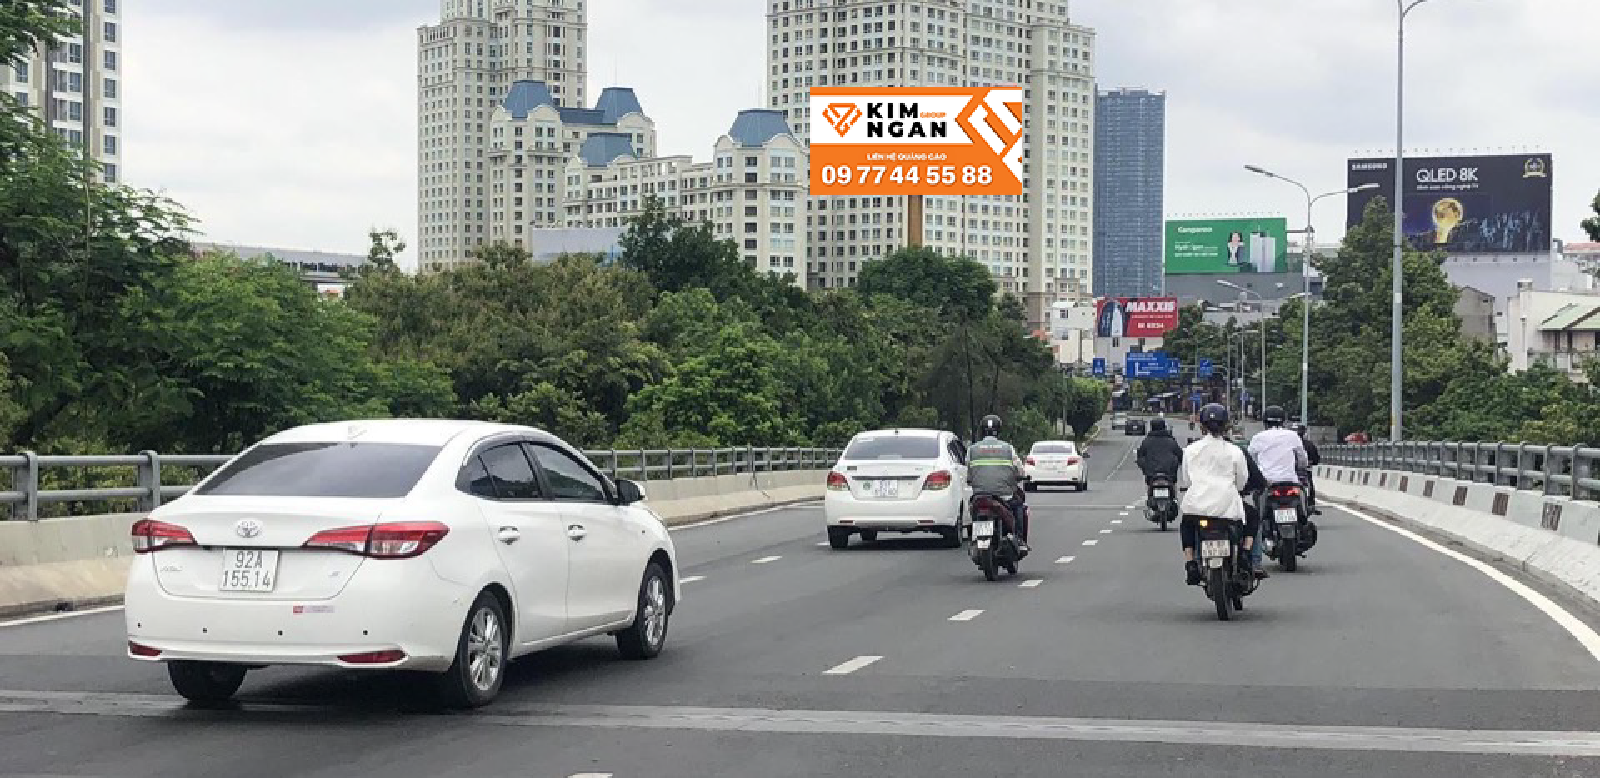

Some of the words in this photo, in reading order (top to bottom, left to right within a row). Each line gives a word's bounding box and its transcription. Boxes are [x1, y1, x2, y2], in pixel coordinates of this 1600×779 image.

[1416, 167, 1457, 183] QLED
[1459, 167, 1479, 182] 8K
[235, 550, 263, 569] 92A
[222, 570, 271, 588] 155.14
